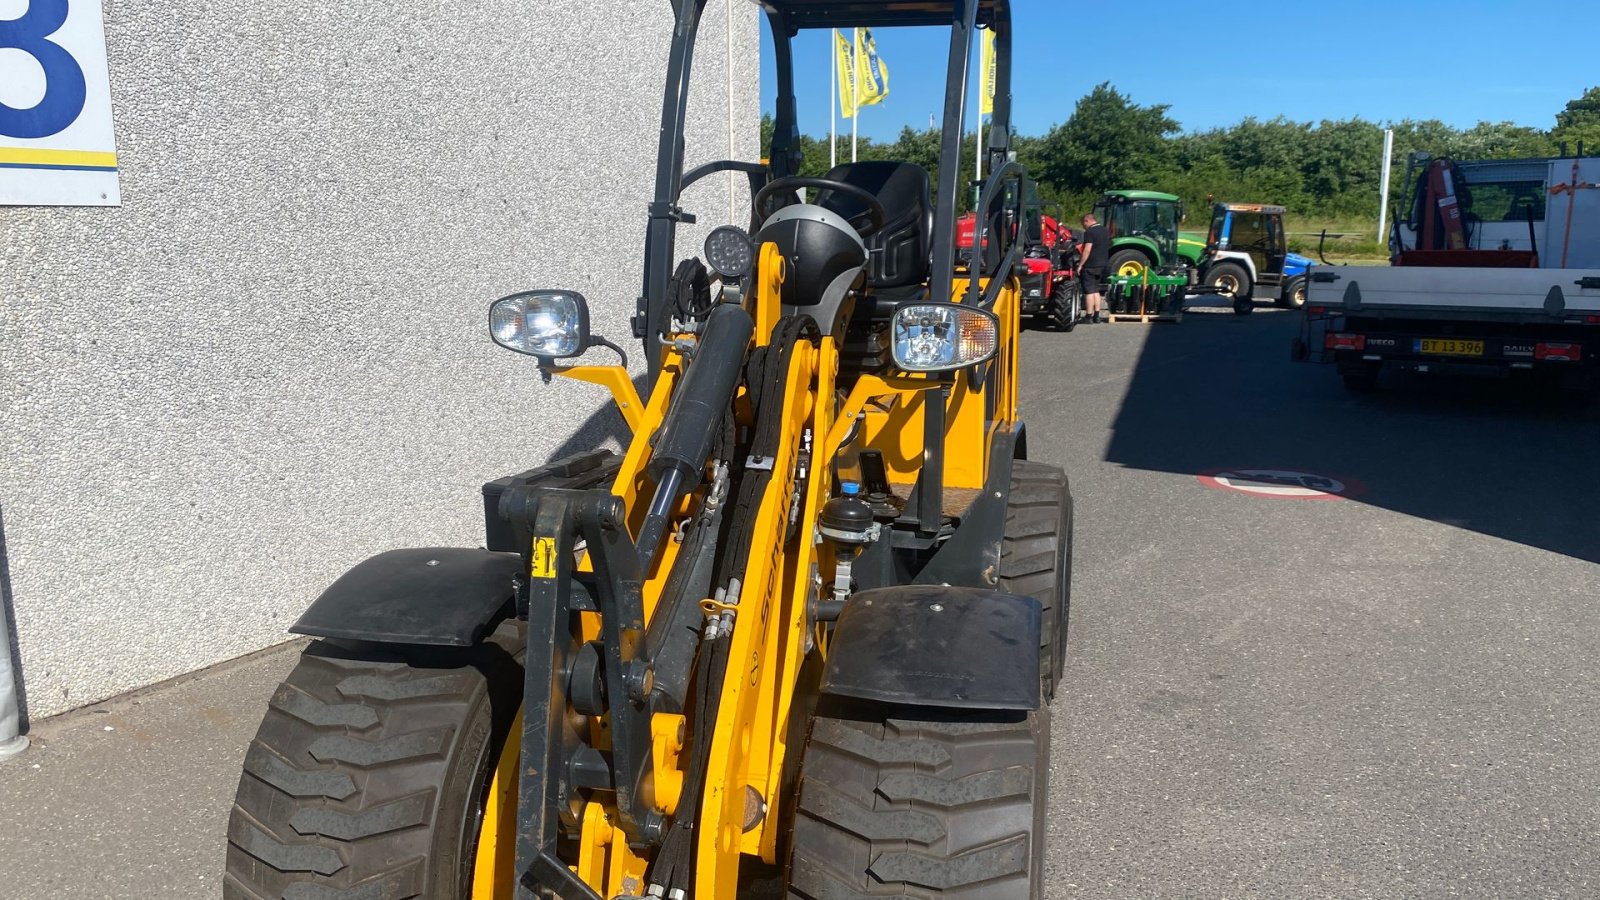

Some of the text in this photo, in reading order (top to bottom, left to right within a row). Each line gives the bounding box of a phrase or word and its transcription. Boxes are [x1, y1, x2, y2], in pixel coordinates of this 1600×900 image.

[1367, 338, 1395, 346] IVECO
[1422, 341, 1481, 353] BT 13 396
